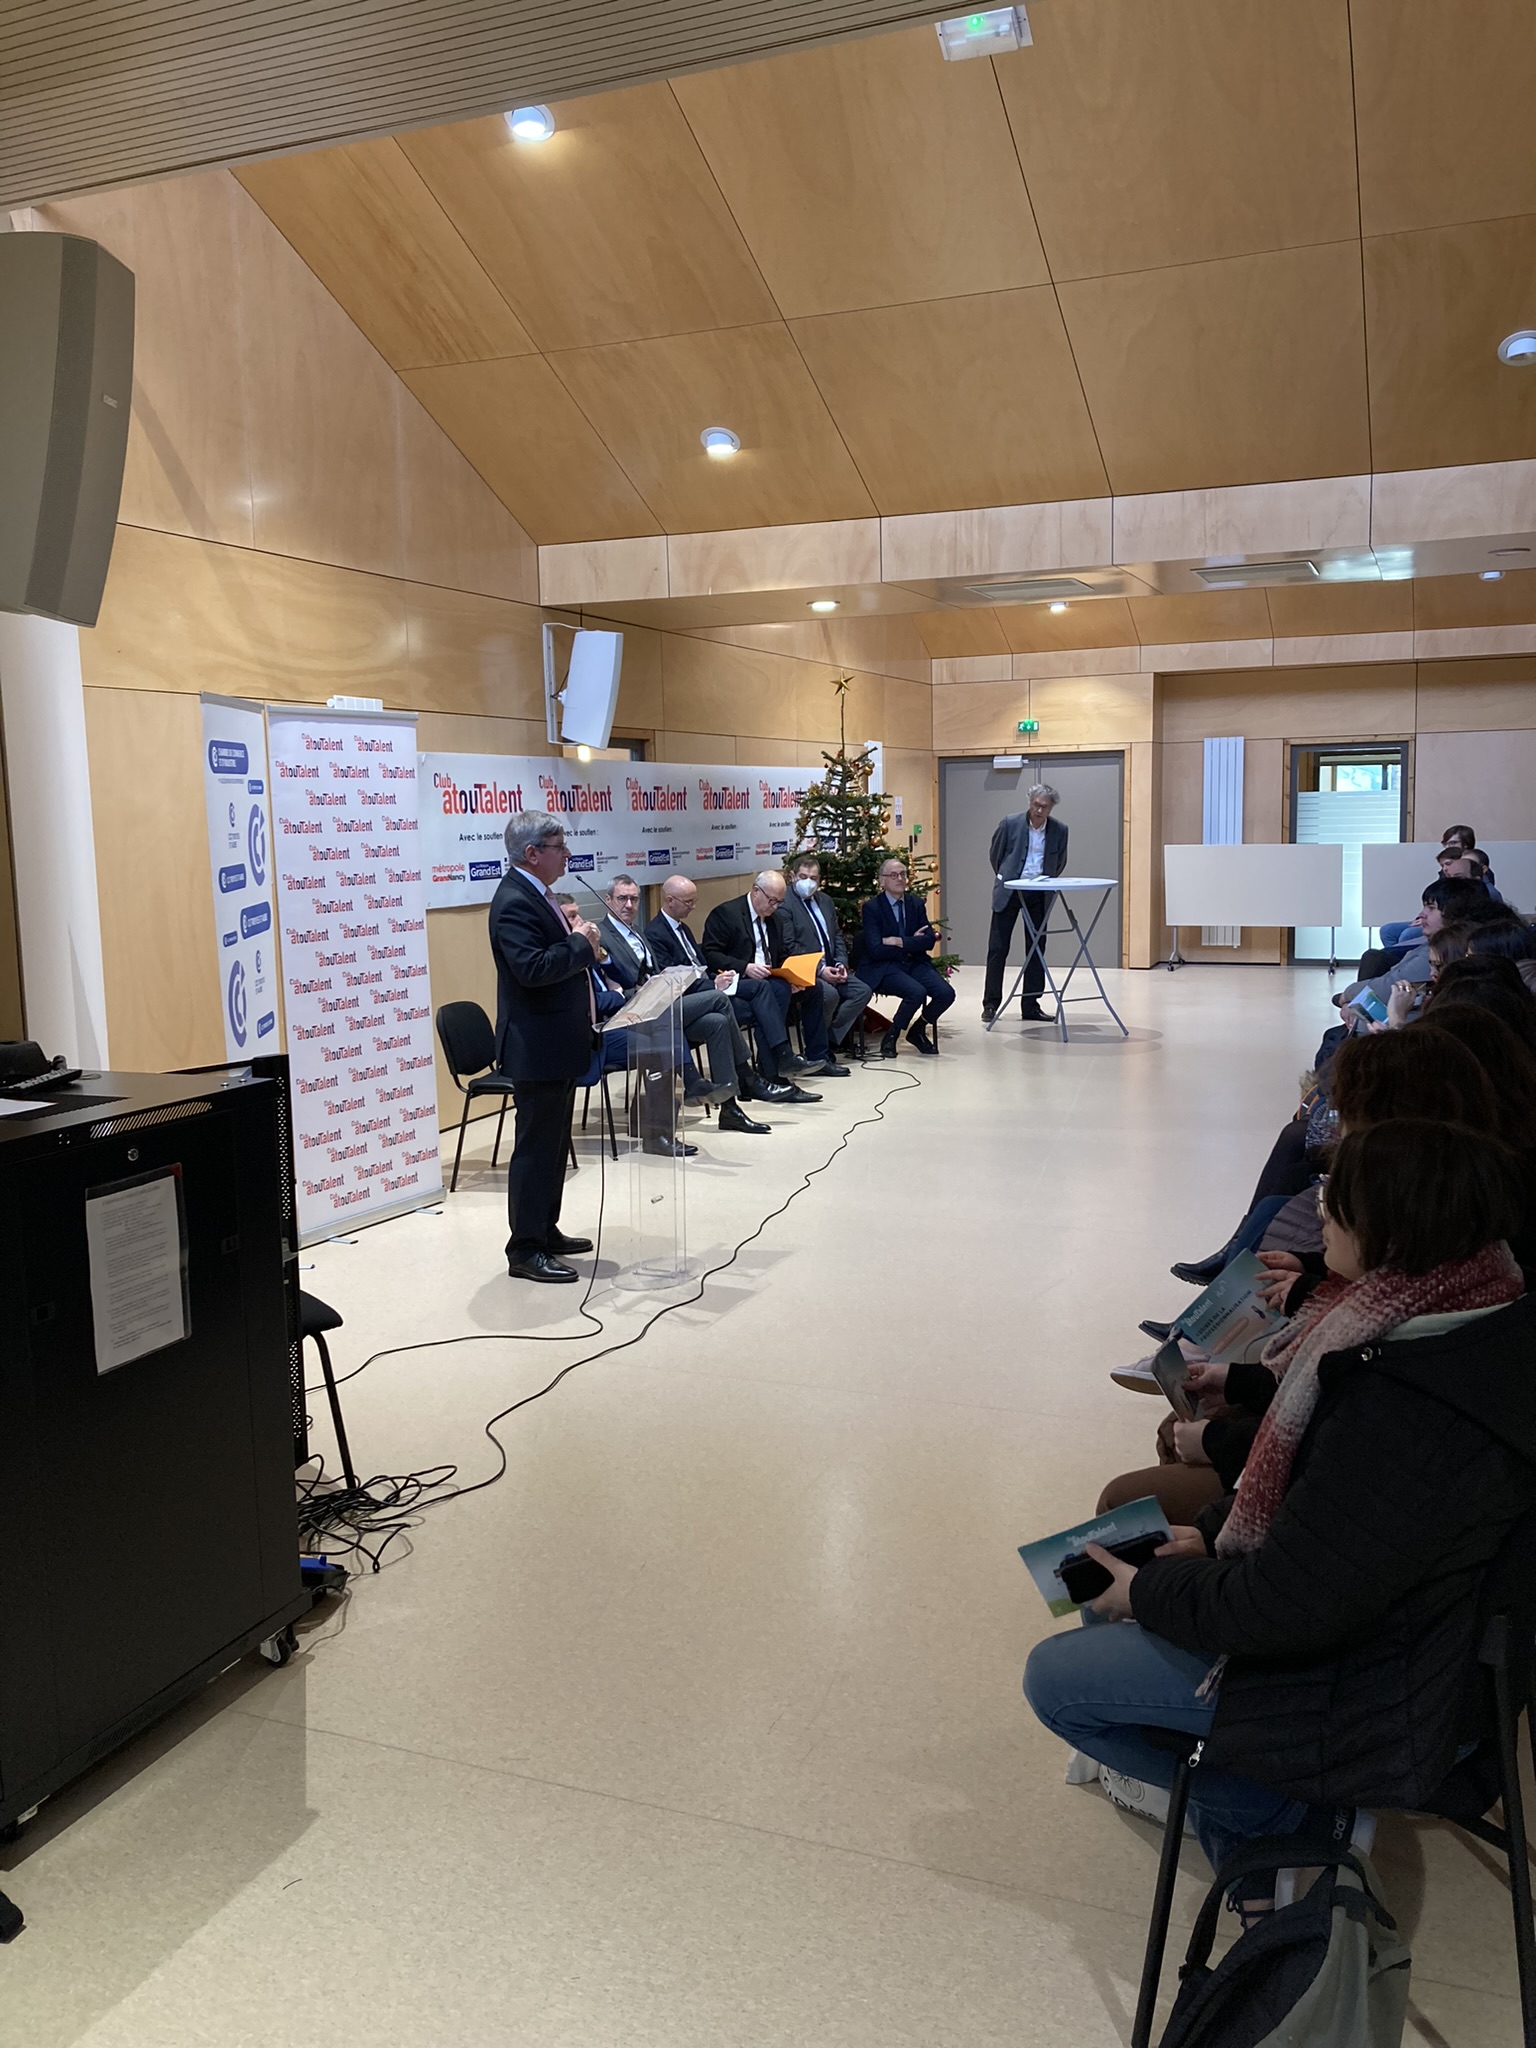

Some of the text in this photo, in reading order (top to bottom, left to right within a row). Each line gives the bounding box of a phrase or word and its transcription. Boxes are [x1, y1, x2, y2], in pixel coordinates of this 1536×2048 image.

[434, 773, 451, 788] Club
[539, 775, 553, 789] Club
[626, 777, 638, 790] Club
[699, 779, 710, 791] Club
[759, 780, 768, 791] Club
[442, 782, 523, 814] atouTalent
[546, 783, 613, 812] atouTalent
[632, 784, 687, 811] atouTalent
[703, 785, 750, 810] atouTalent
[459, 832, 503, 841] Avec le soutien
[563, 829, 573, 837] vec
[432, 863, 465, 873] métropole
[432, 874, 465, 882] GrandNancy
